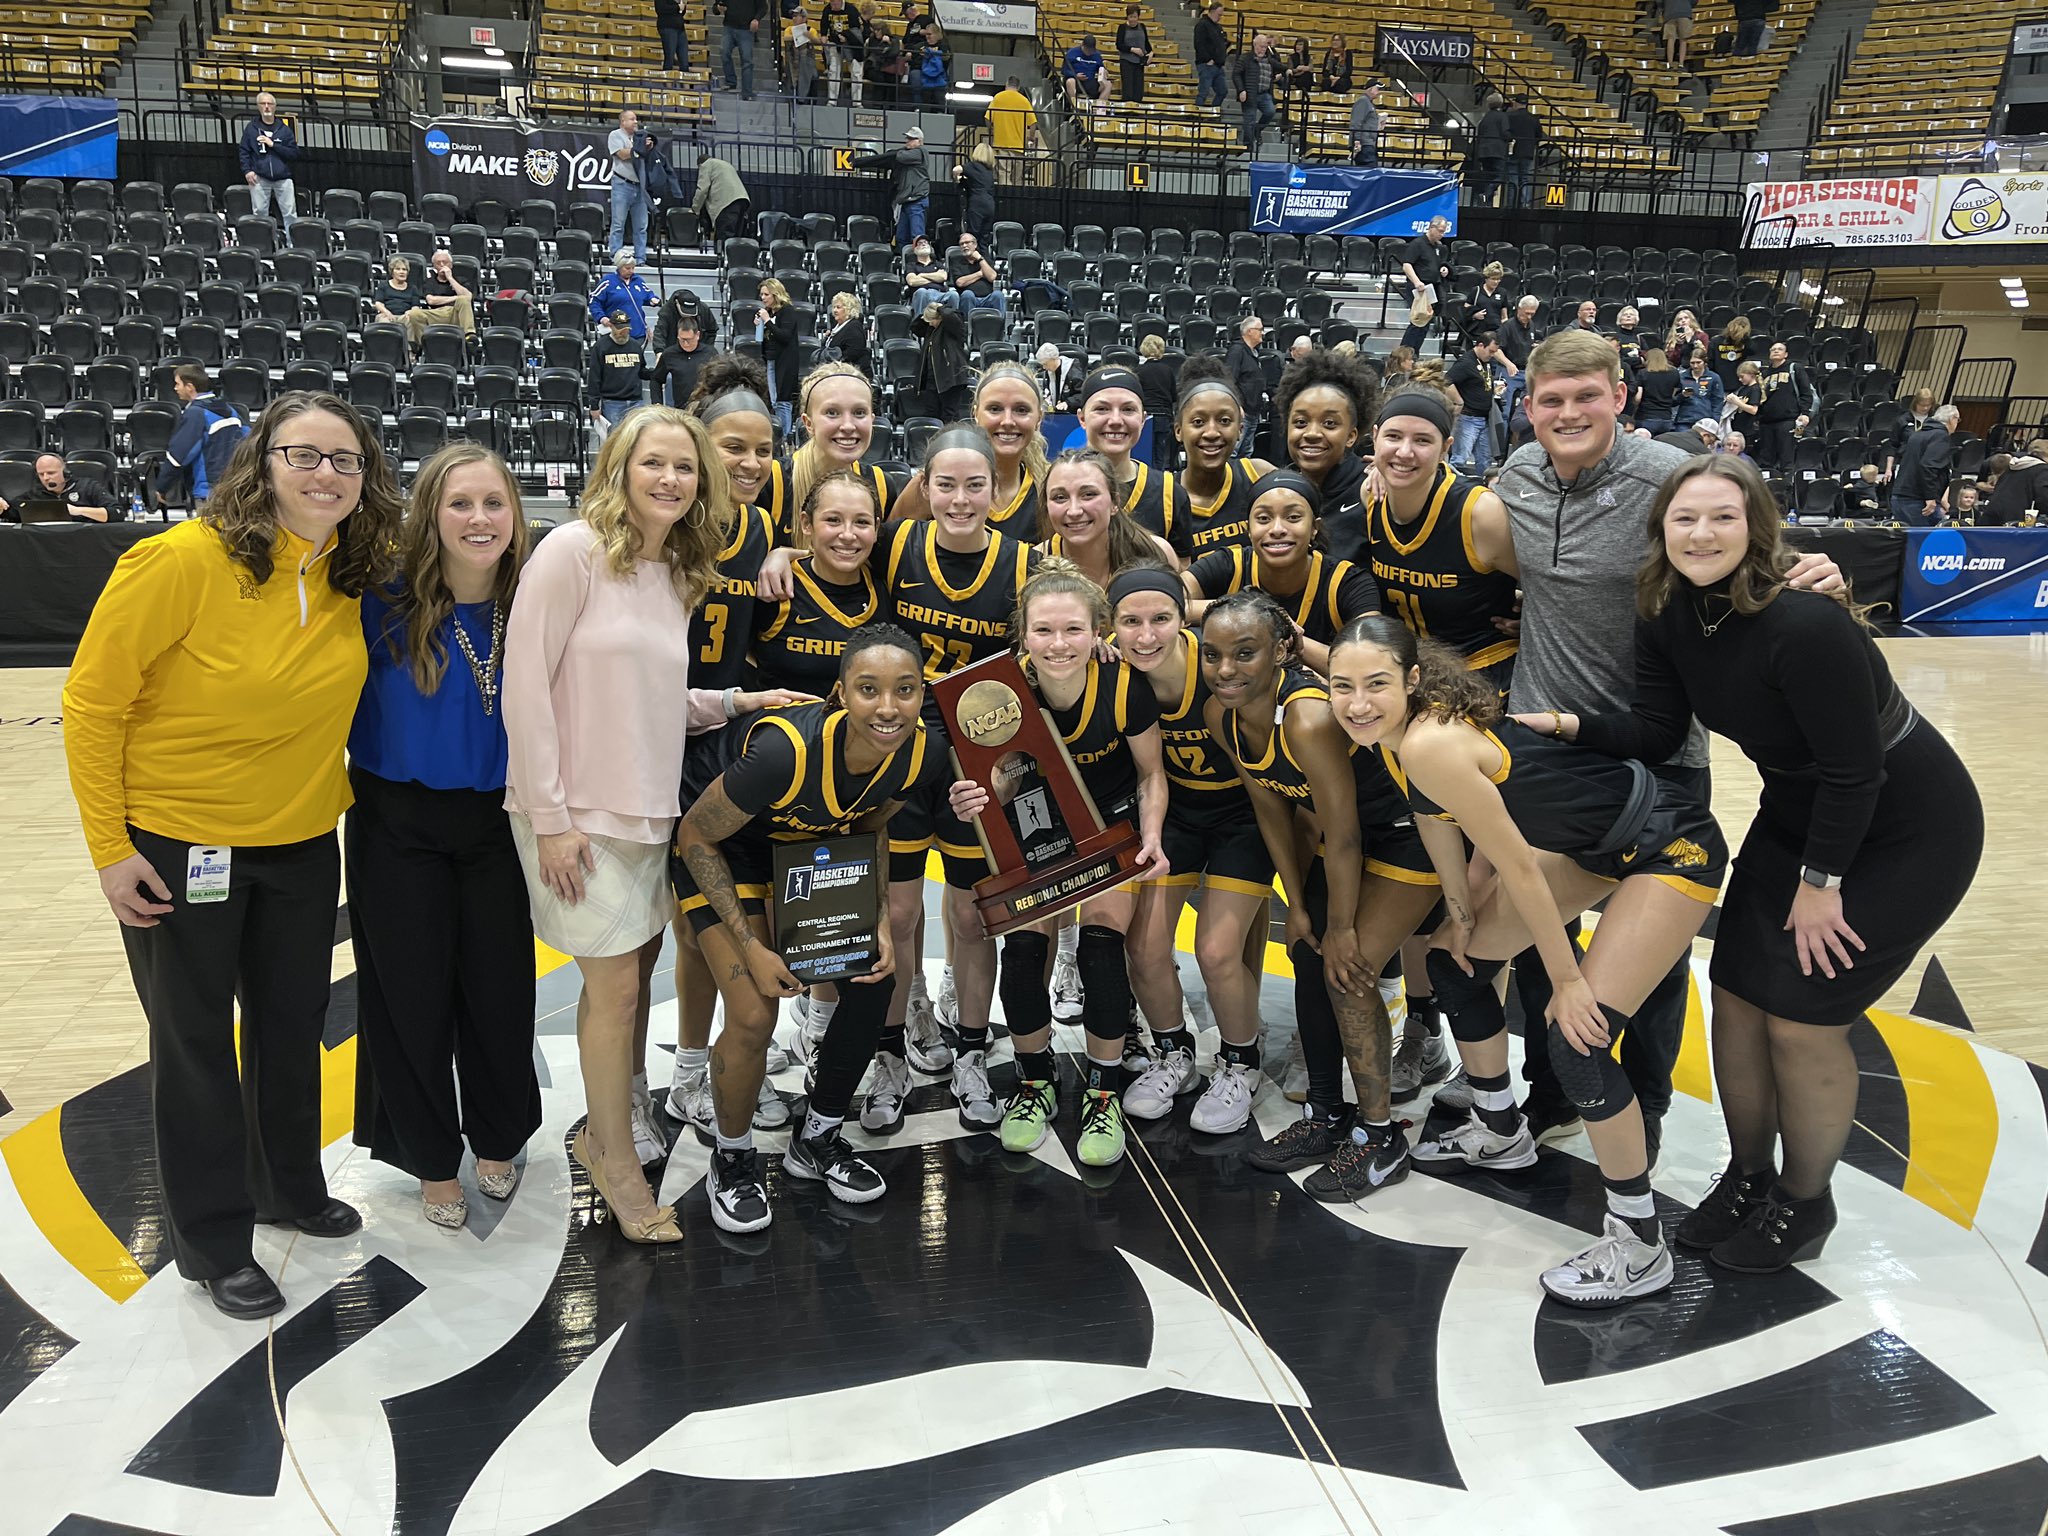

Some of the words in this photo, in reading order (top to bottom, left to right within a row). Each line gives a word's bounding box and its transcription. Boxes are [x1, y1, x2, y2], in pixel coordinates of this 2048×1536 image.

[941, 16, 975, 26] Schaffer
[985, 20, 1028, 29] Associates
[427, 141, 450, 150] NCAA
[452, 142, 477, 151] Division
[448, 154, 519, 176] MAKE
[836, 150, 853, 170] K
[1133, 166, 1144, 184] L
[1547, 186, 1564, 204] M
[2003, 178, 2044, 196] Sports
[1286, 195, 1348, 209] BASKETBALL
[1762, 179, 1918, 218] HORSESHOE
[1955, 194, 1996, 209] GOLDEN
[1285, 208, 1337, 218] CHAMPIONSHIP
[1823, 213, 1834, 227] &
[1839, 210, 1890, 227] GRILL
[1973, 212, 1987, 224] Q
[1411, 220, 1452, 234] #D2B
[1757, 237, 1780, 246] 1002
[1795, 236, 1810, 246] 8th
[1845, 233, 1913, 244] 785.625.3103
[1921, 555, 2006, 571] NCAA.com
[896, 600, 1008, 637] GRIFFONS
[700, 603, 729, 663] 3
[966, 701, 1022, 739] NCAA
[1166, 745, 1216, 776] 12
[998, 764, 1030, 785] DIVISION
[1035, 836, 1071, 857] BASKETBALL
[813, 864, 869, 882] BASKETBALL
[811, 876, 860, 890] CHAMPIONSHIP
[1015, 885, 1061, 912] REGIONAL
[1061, 863, 1111, 893] CHAMPION
[797, 917, 826, 928] CENTRAL
[827, 913, 859, 923] REGIONAL
[786, 946, 800, 954] ALL
[801, 937, 851, 952] TOURNAMENT
[851, 934, 871, 944] TEAM
[790, 959, 814, 971] MOST
[814, 950, 869, 966] OUTSTANDING
[814, 963, 846, 975] PLAYER
